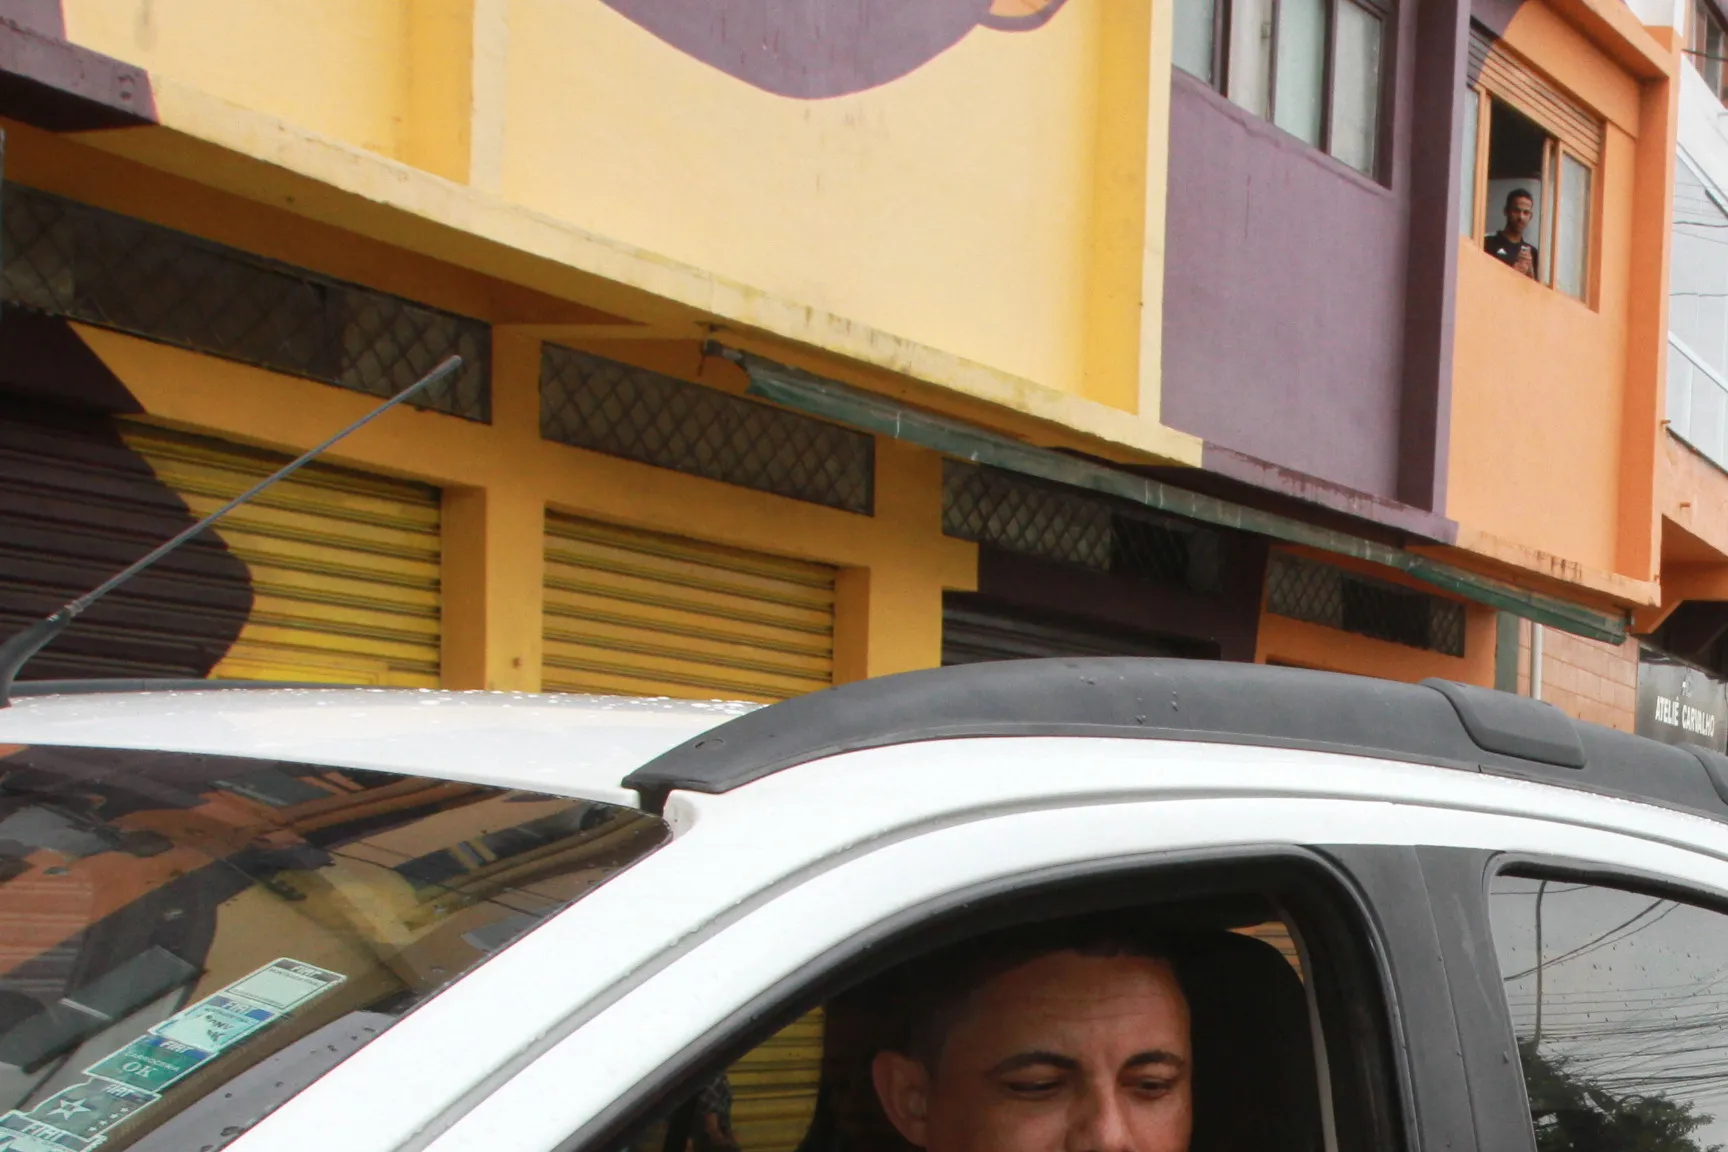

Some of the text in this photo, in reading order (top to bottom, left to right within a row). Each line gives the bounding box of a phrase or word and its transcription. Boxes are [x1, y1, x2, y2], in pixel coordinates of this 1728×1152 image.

[1682, 704, 1715, 738] CARVALHO
[160, 1040, 194, 1053] FIAT
[122, 1061, 157, 1078] OK
[103, 1084, 136, 1097] FIAT
